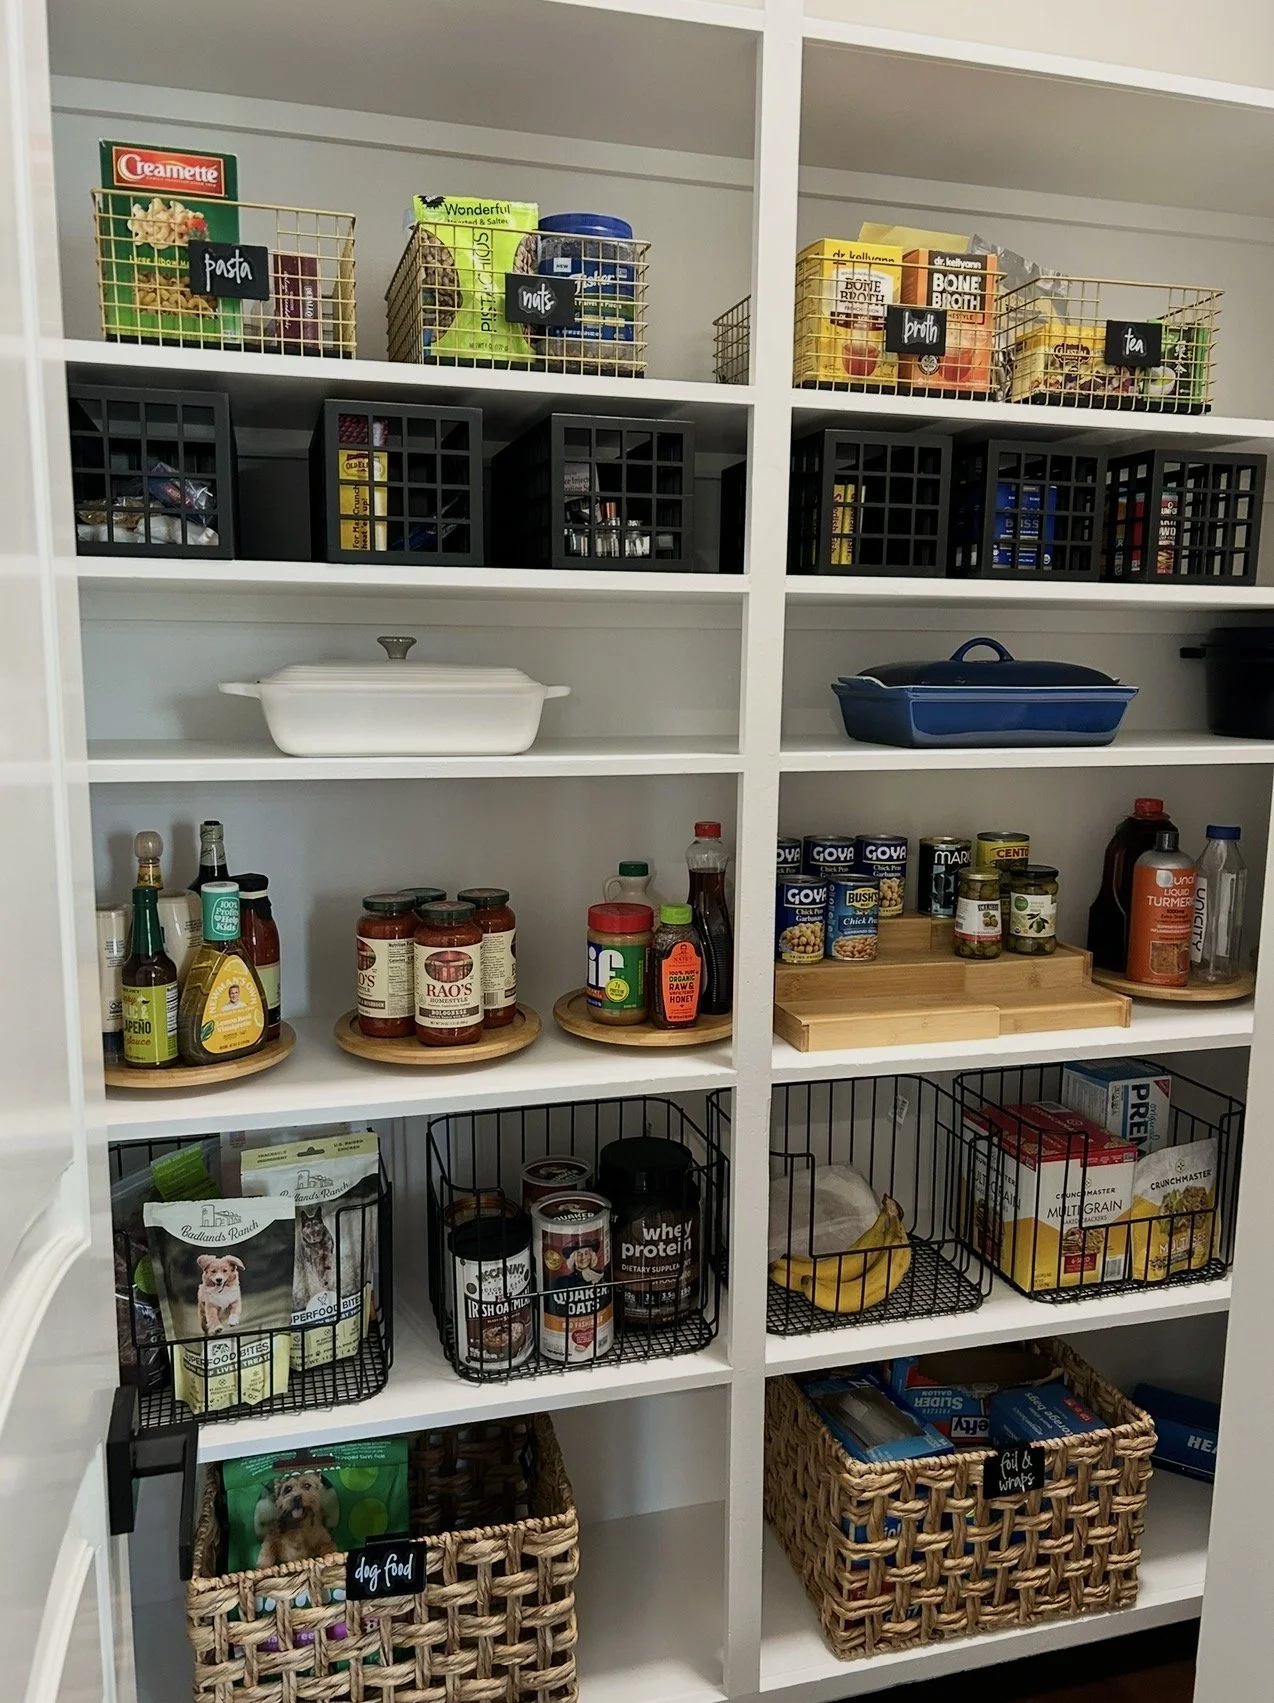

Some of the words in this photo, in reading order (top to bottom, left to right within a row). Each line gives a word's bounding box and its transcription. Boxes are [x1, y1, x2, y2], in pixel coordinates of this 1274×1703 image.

[445, 202, 511, 216] Wonderful
[204, 249, 253, 292] pasta
[946, 257, 982, 270] kellyann
[569, 270, 615, 295] Fisher
[845, 277, 882, 293] BONE
[932, 272, 981, 292] BONE
[522, 283, 556, 314] nuts
[839, 290, 886, 307] BROTH
[931, 291, 981, 311] BROTH
[903, 310, 938, 344] broth
[1124, 327, 1145, 356] tea
[1005, 518, 1040, 529] BISS
[352, 532, 360, 549] For
[360, 530, 369, 550] heat
[776, 848, 801, 863] OYA
[812, 846, 855, 862] GOYA
[865, 845, 907, 860] GOYA
[996, 848, 1029, 859] CENTO
[820, 865, 837, 873] Chick
[787, 887, 827, 904] GOYA
[847, 889, 879, 904] BUSH'S
[1163, 888, 1190, 897] LIQUID
[1146, 895, 1194, 908] TURMER
[221, 915, 239, 925] Help
[795, 908, 812, 916] Chick
[1191, 887, 1206, 952] UNICITY
[215, 922, 236, 932] Kids
[842, 917, 866, 926] Chick
[588, 945, 625, 988] if
[357, 972, 376, 988] O'S
[668, 983, 688, 991] RAW
[426, 982, 473, 998] RAO'S
[669, 995, 694, 1003] HONEY
[127, 1005, 138, 1019] LIC
[140, 1005, 149, 1019] &
[124, 1019, 152, 1034] APEÑO
[1129, 1083, 1150, 1148] PREM
[1150, 1169, 1212, 1191] CRUNCHMASTER
[320, 1181, 349, 1199] Ranch
[1056, 1187, 1116, 1200] CUNCMASTER
[1083, 1215, 1108, 1223] RACKERS
[181, 1224, 226, 1243] Badlands
[227, 1219, 260, 1240] Ranch
[642, 1218, 693, 1240] whey
[621, 1237, 692, 1260] protein
[621, 1263, 651, 1273] DIETARY
[651, 1258, 691, 1273] SUPPLEMNT
[292, 1303, 338, 1324] PERFOOD
[342, 1295, 361, 1310] BITE
[467, 1299, 495, 1318] IRSH
[568, 1298, 601, 1316] OATS
[184, 1352, 237, 1368] SUPEFOOD
[914, 1396, 964, 1410] SLIDER
[953, 1417, 989, 1436] efty
[1000, 1450, 1019, 1480] foil
[1021, 1450, 1033, 1469] &
[999, 1472, 1036, 1493] wraps
[354, 1556, 381, 1592] dog
[381, 1553, 415, 1588] food
